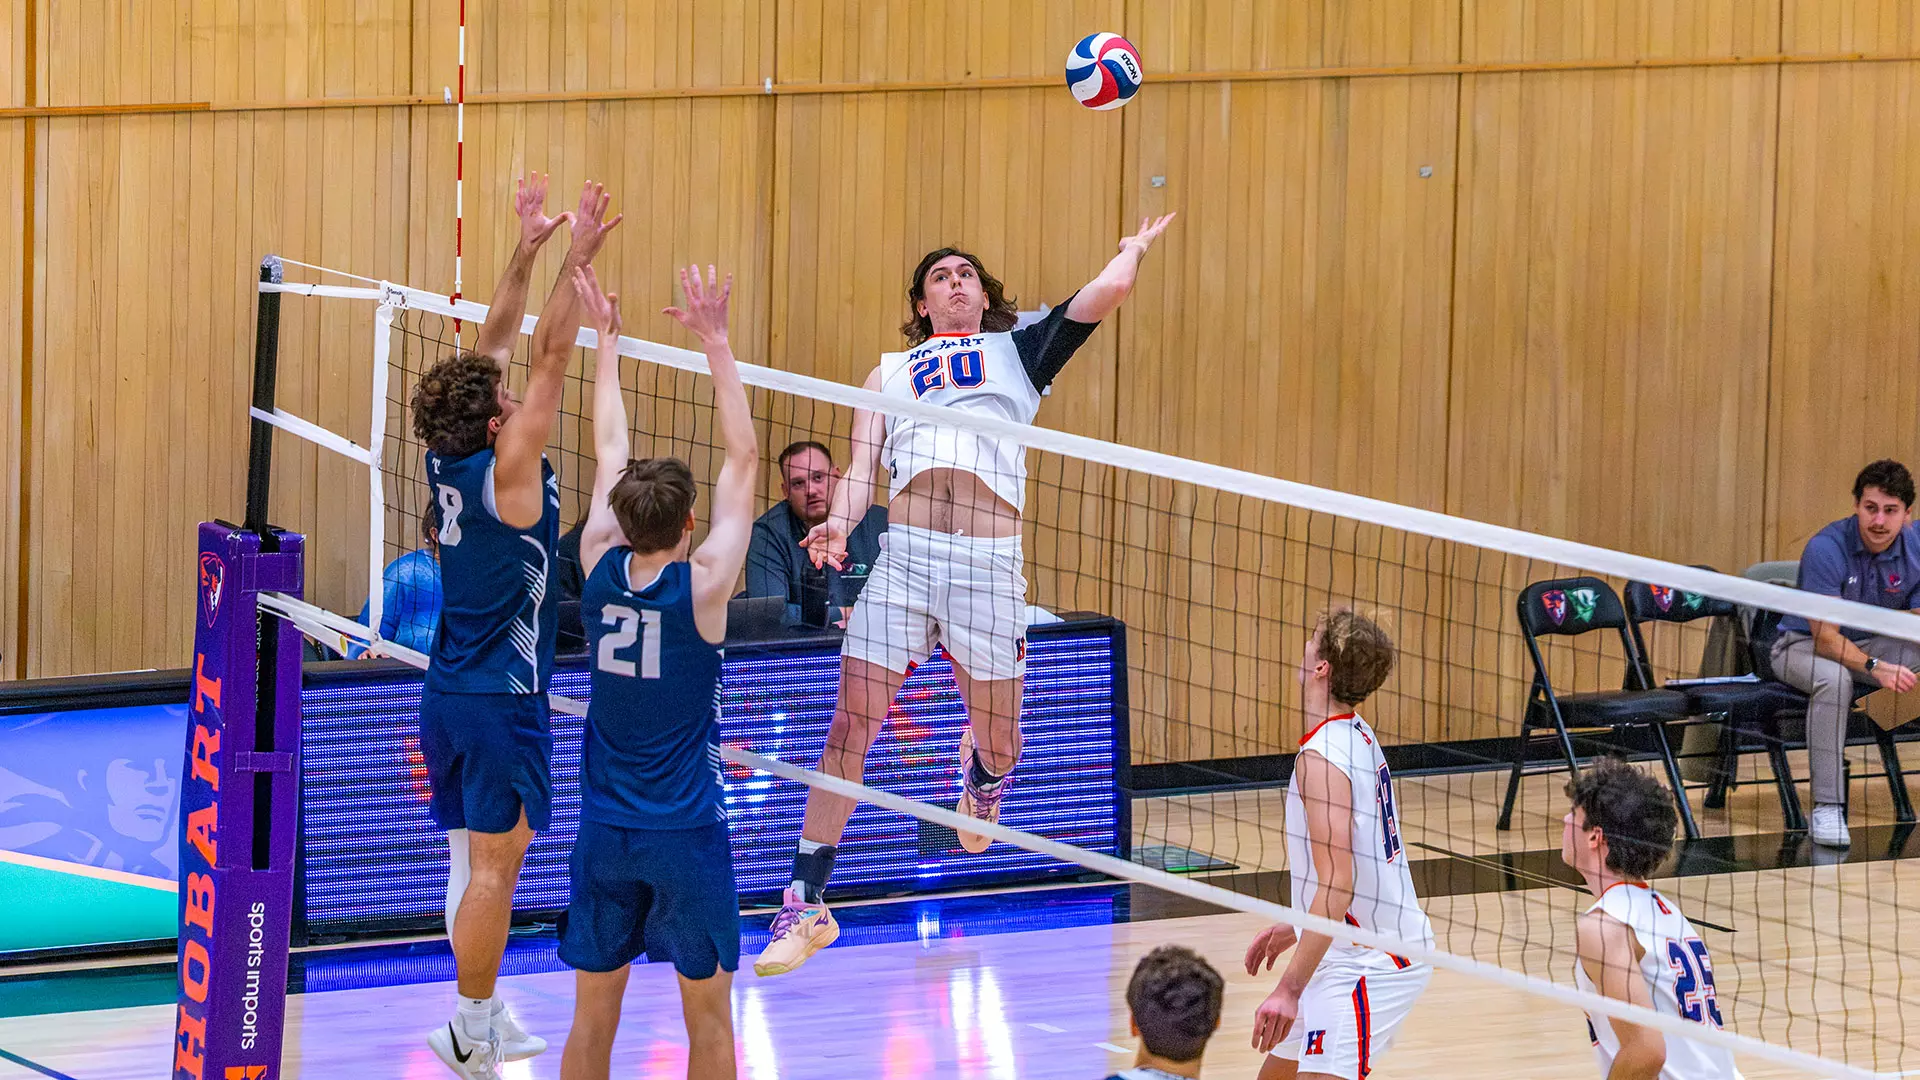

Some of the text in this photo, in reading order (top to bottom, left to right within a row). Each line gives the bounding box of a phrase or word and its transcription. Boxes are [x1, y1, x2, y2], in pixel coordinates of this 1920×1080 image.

[1121, 53, 1137, 79] NCAA
[910, 349, 986, 400] 20
[432, 457, 441, 475] T
[436, 483, 463, 547] 8
[597, 603, 662, 680] 21
[175, 653, 222, 1080] HOBART
[248, 902, 265, 968] sports
[241, 970, 261, 1050] imports
[1666, 937, 1724, 1031] 25
[1305, 1029, 1326, 1056] H
